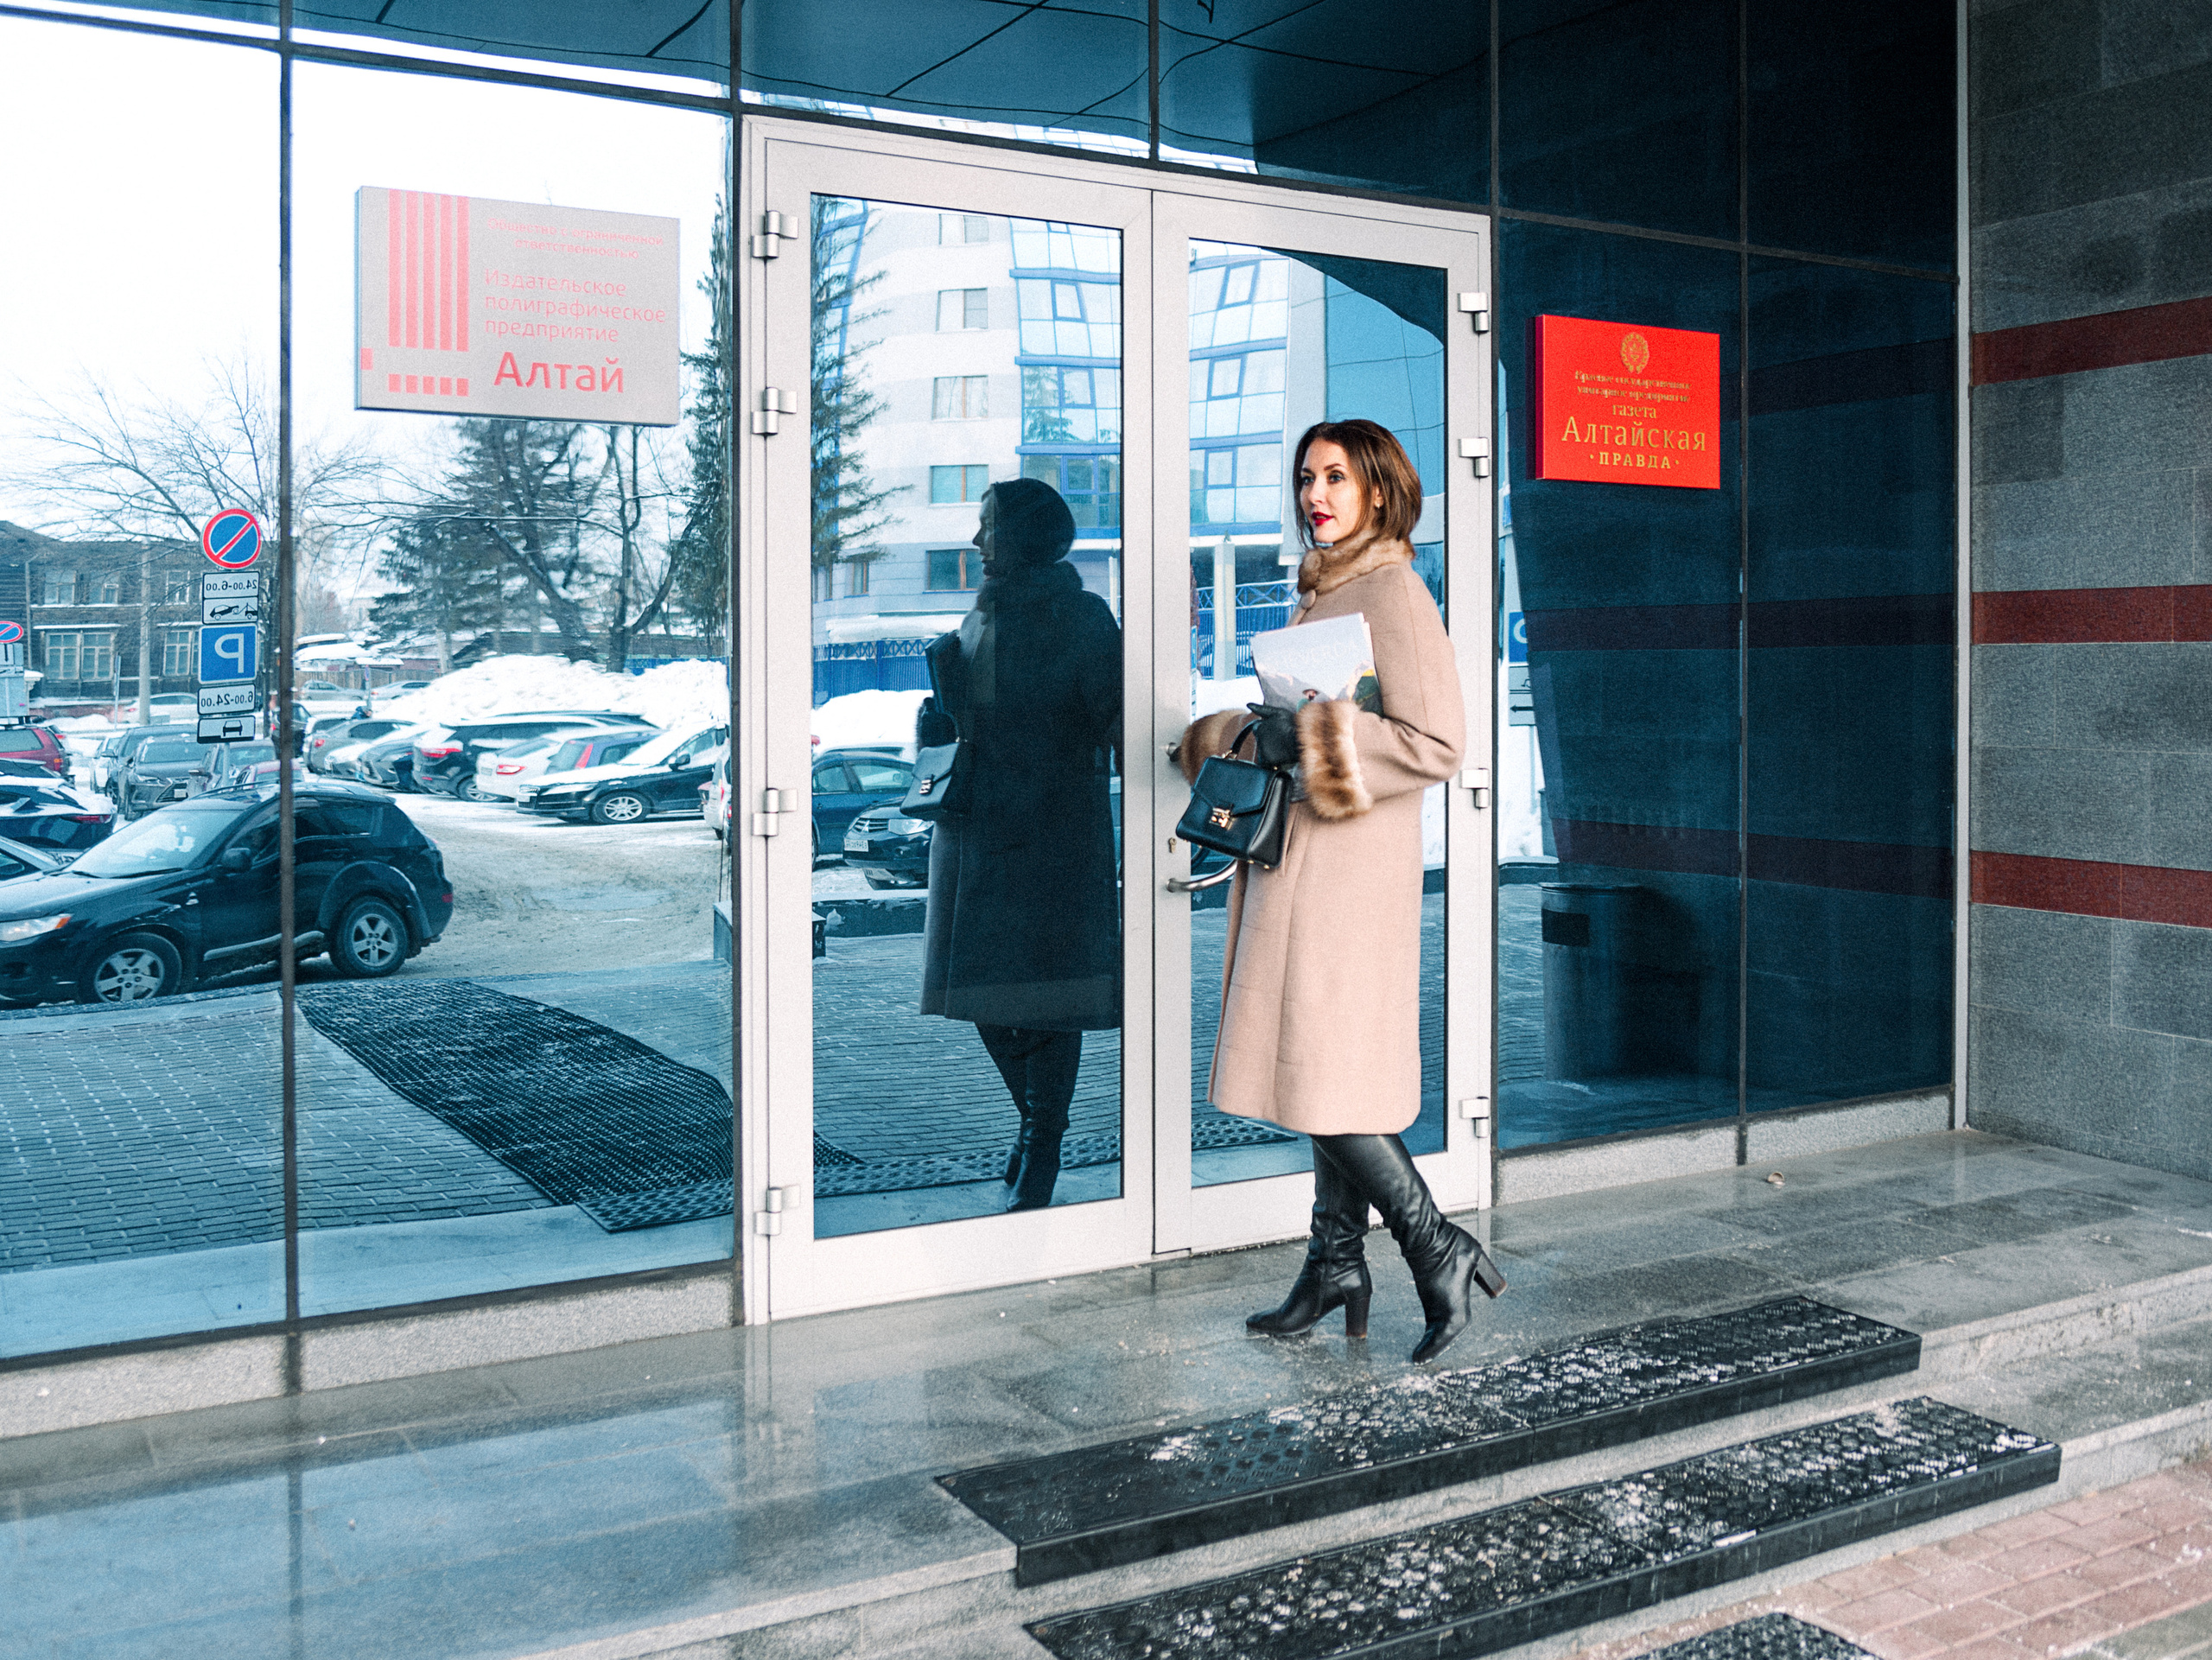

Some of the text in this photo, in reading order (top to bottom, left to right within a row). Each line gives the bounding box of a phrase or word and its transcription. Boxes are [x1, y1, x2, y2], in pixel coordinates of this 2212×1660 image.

[486, 217, 664, 246] Общество с ограниченной
[513, 239, 639, 259] ответственностью
[485, 269, 627, 297] Издательское
[485, 295, 666, 324] полиграфическое
[485, 319, 620, 343] предприятие
[493, 351, 624, 393] Алтай
[1612, 404, 1657, 419] газета
[1560, 416, 1707, 451] Алтайская
[1599, 452, 1671, 469] ПРАВДА
